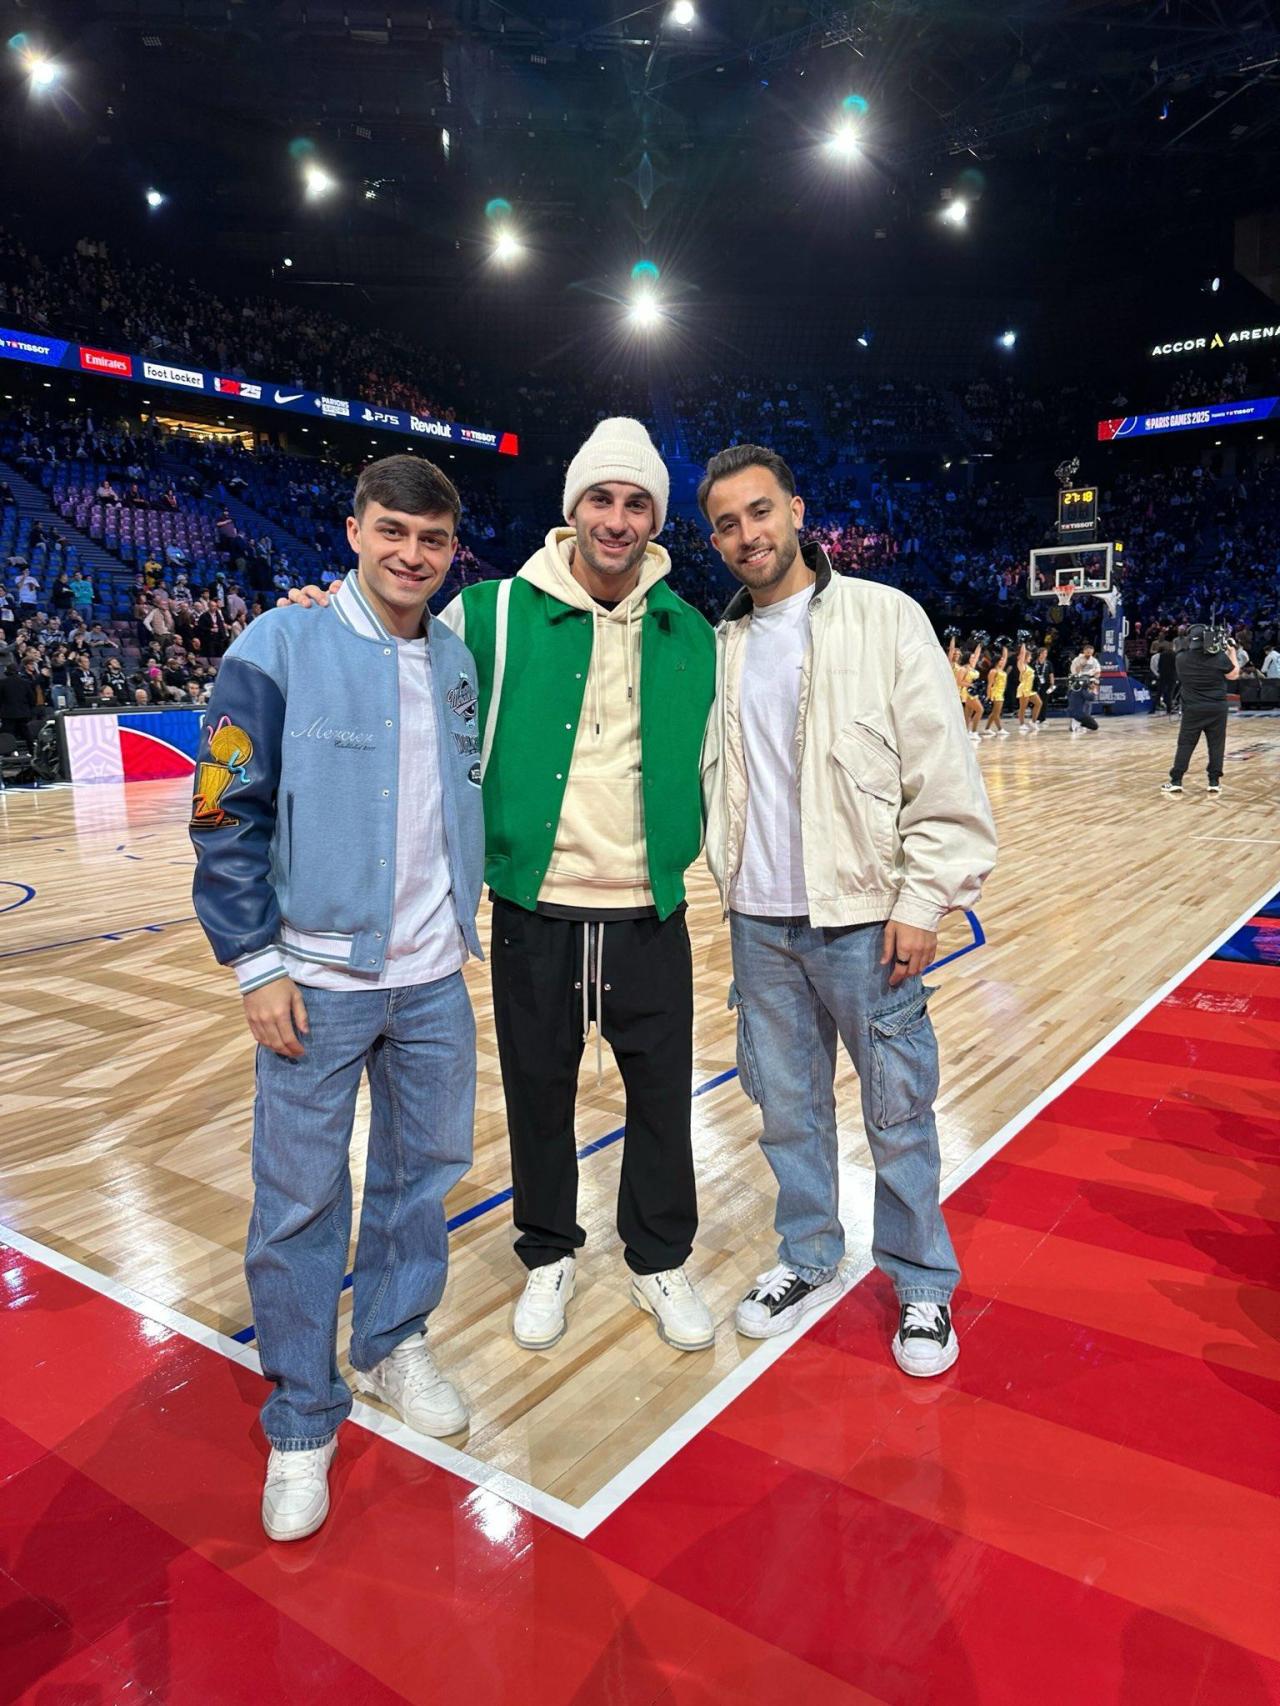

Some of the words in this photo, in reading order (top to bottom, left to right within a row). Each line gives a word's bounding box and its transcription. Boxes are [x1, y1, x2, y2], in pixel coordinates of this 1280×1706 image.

[1152, 338, 1206, 356] ACCOR
[85, 353, 127, 370] Emirates
[147, 366, 168, 379] Foot
[170, 370, 201, 385] Locker
[374, 412, 399, 425] PS5
[1192, 410, 1210, 424] 2025
[410, 415, 452, 438] Revolut
